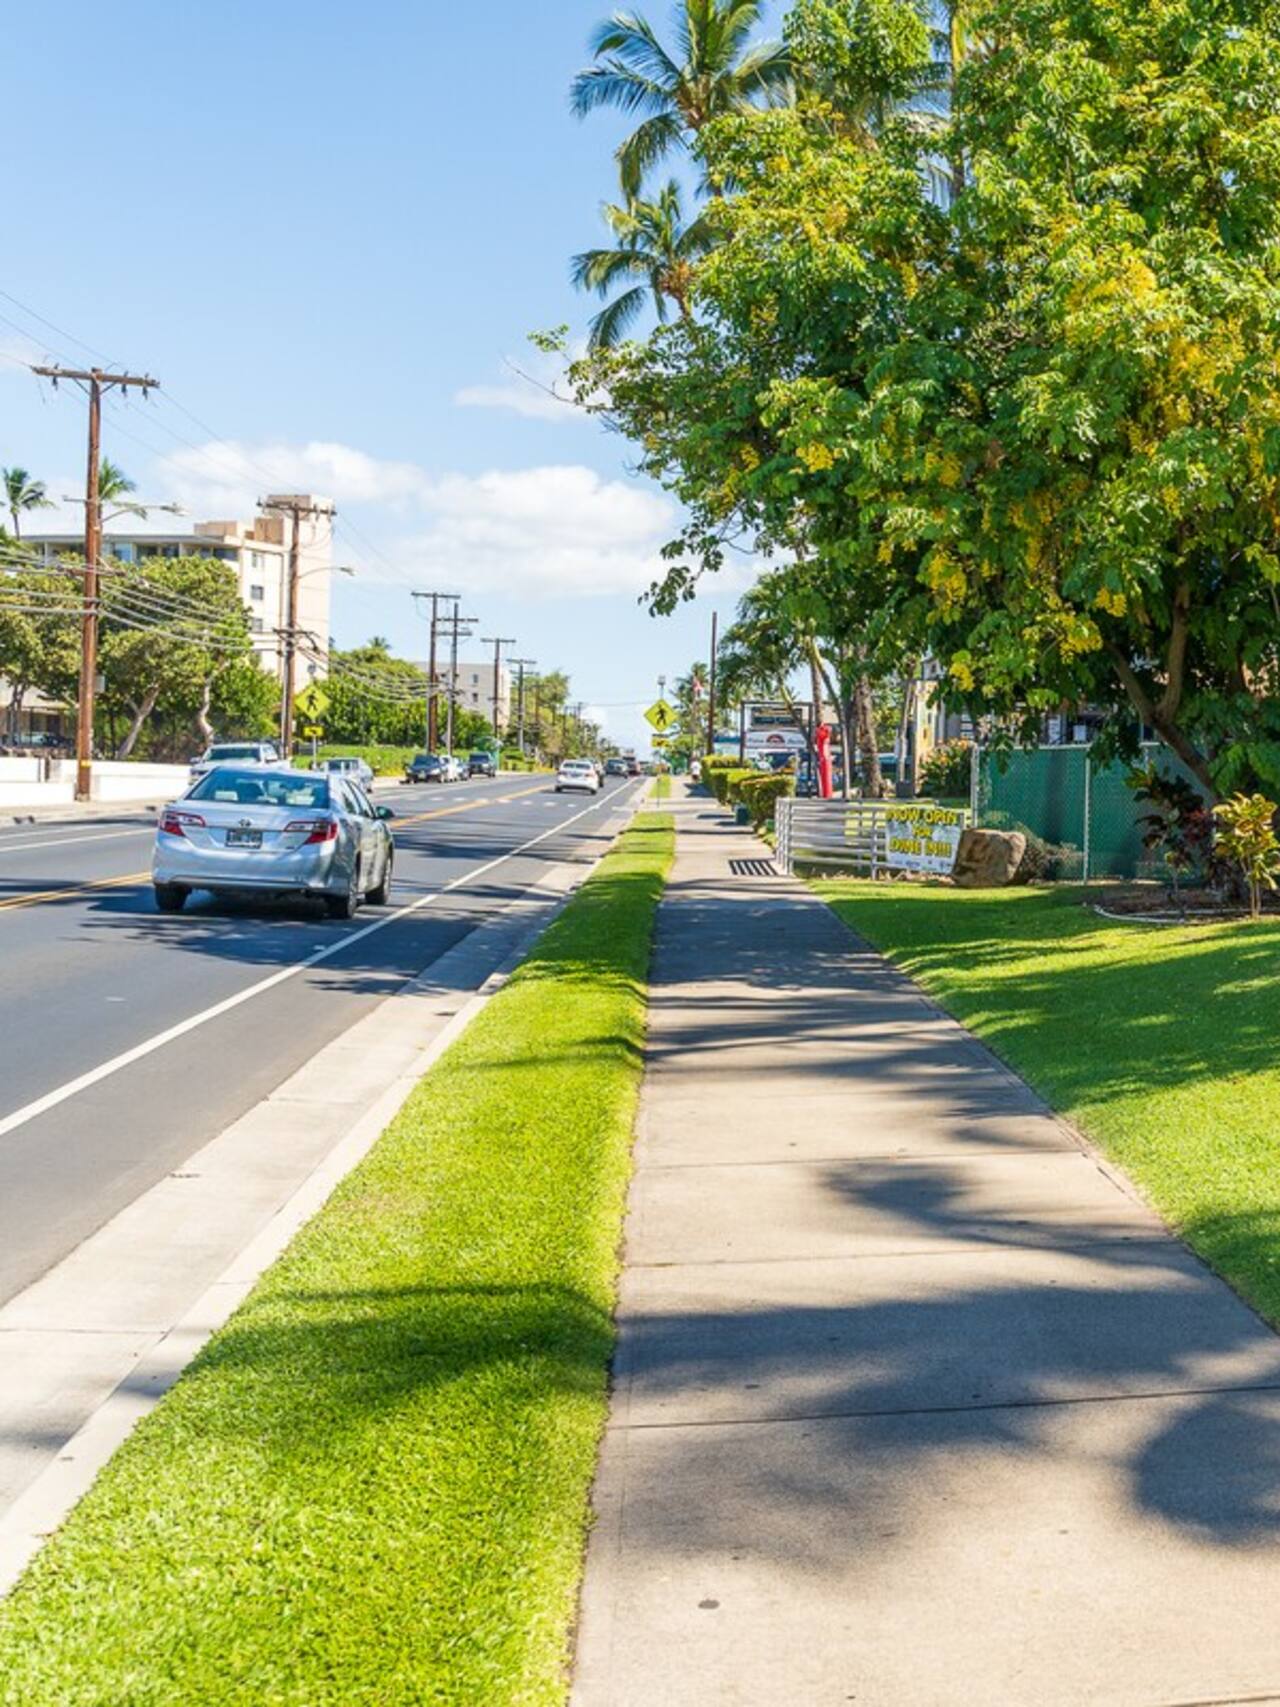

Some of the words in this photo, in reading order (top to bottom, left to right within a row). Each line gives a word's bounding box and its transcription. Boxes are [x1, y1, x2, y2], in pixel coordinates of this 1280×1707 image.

[885, 807, 919, 822] NOW
[924, 809, 957, 825] OPEN
[913, 824, 932, 838] FOR
[889, 838, 921, 855] DINE
